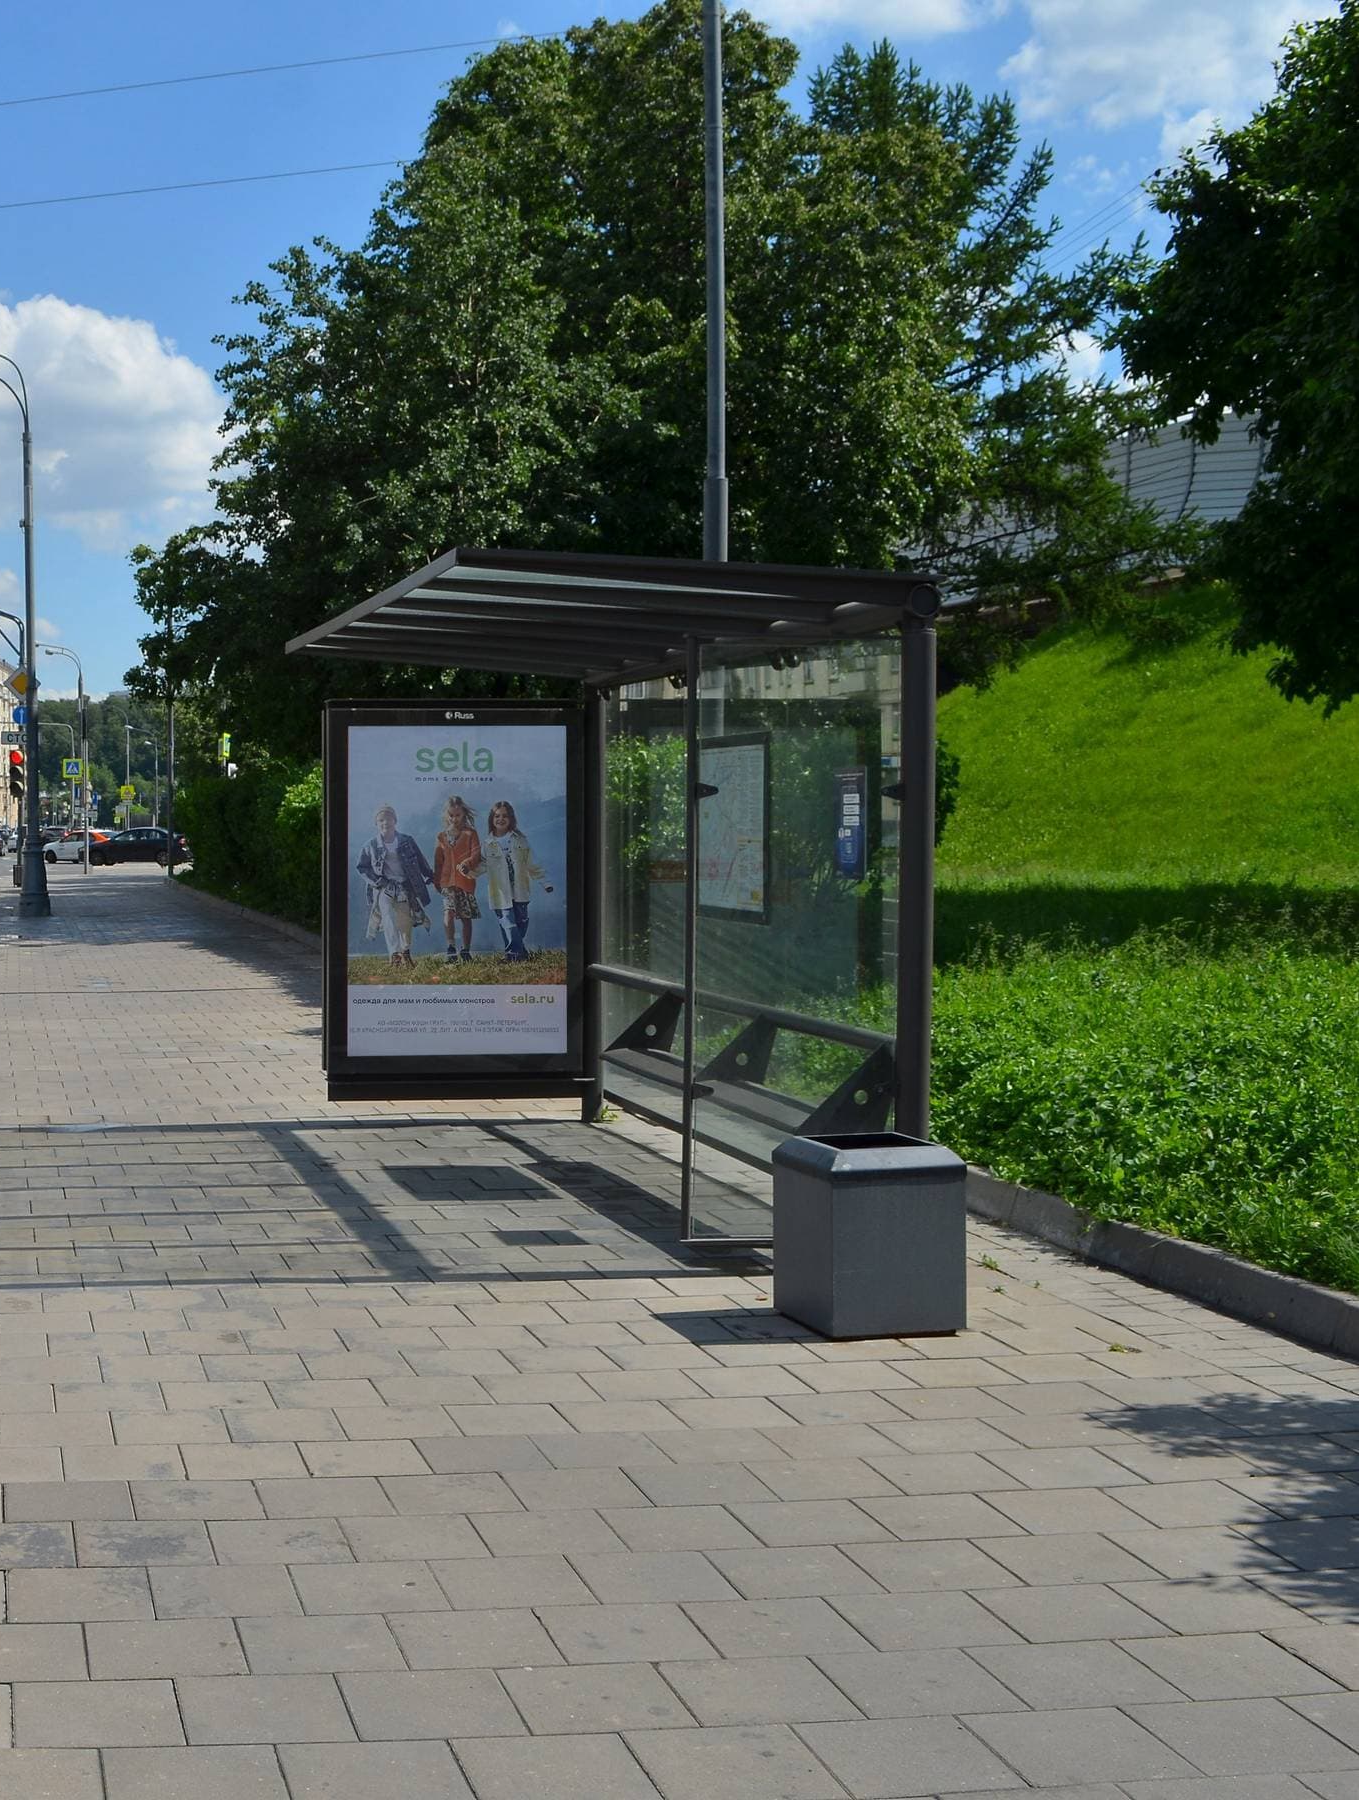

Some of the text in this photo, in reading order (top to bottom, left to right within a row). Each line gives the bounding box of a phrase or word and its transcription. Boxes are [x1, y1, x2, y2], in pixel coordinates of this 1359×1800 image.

[454, 711, 474, 719] Russ
[7, 733, 27, 743] СТО
[415, 741, 494, 772] sela
[422, 996, 458, 1004] любимых
[511, 993, 555, 1004] sela.ru
